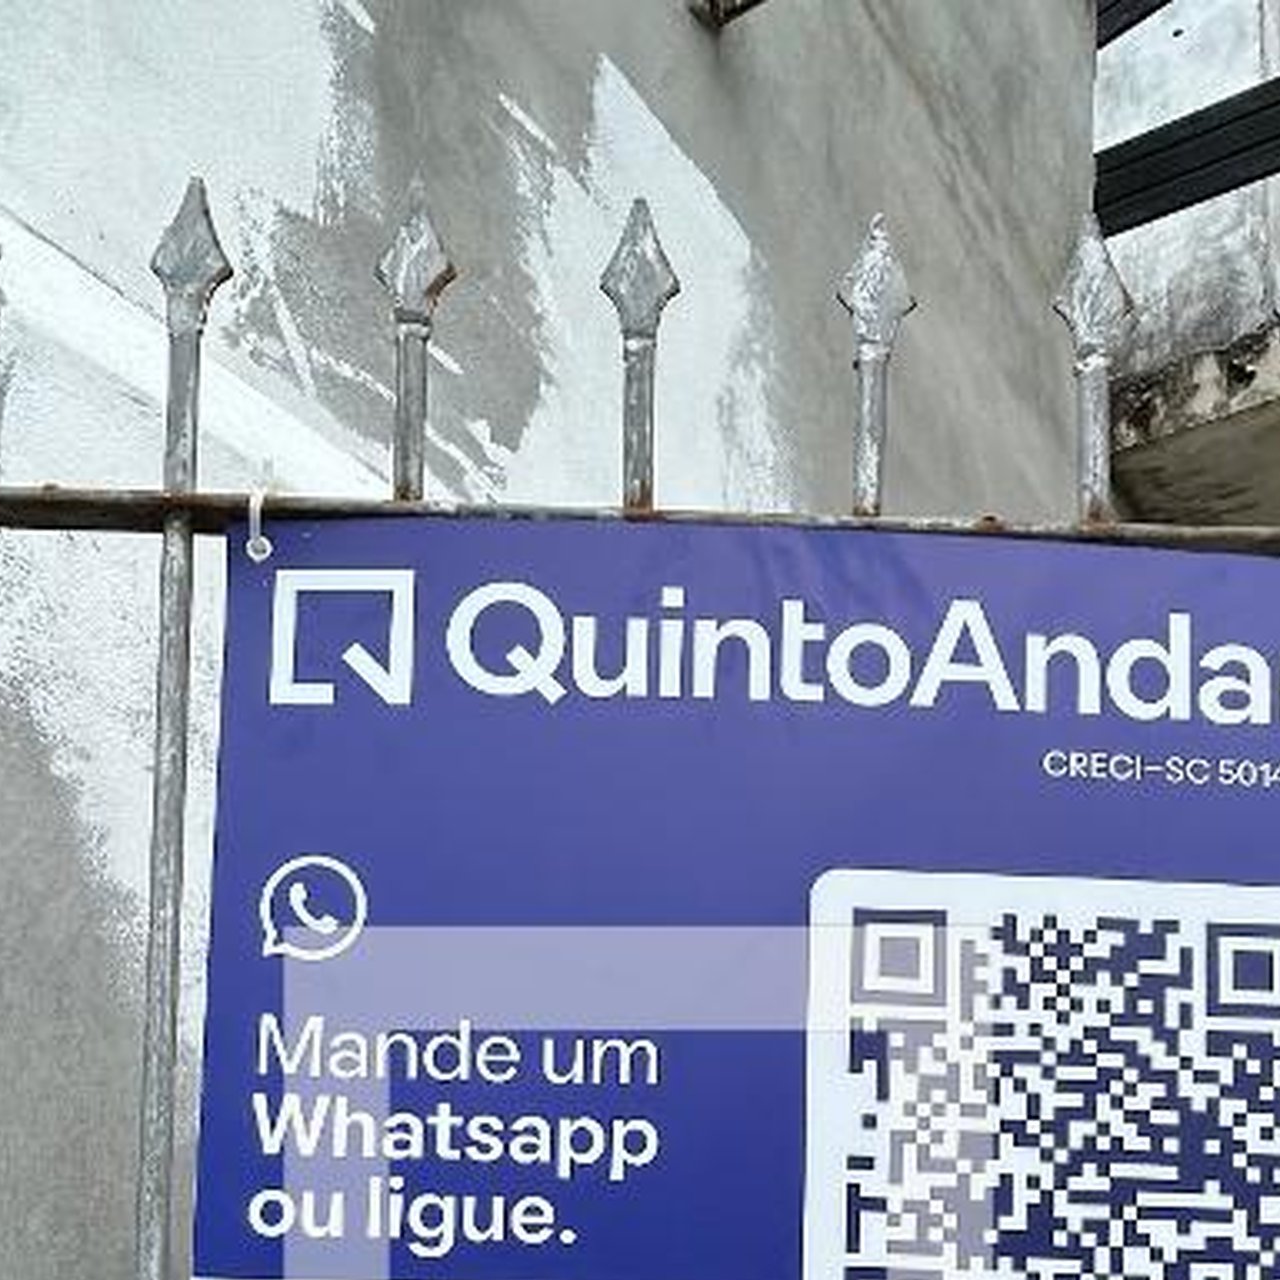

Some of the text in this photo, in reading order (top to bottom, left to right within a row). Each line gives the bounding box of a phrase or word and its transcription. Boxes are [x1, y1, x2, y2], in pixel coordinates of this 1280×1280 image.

[1042, 749, 1212, 785] CRECI-SC
[258, 1014, 658, 1085] Mande um
[252, 1092, 658, 1181] Whatsapp
[249, 1175, 577, 1258] ou ligue.
